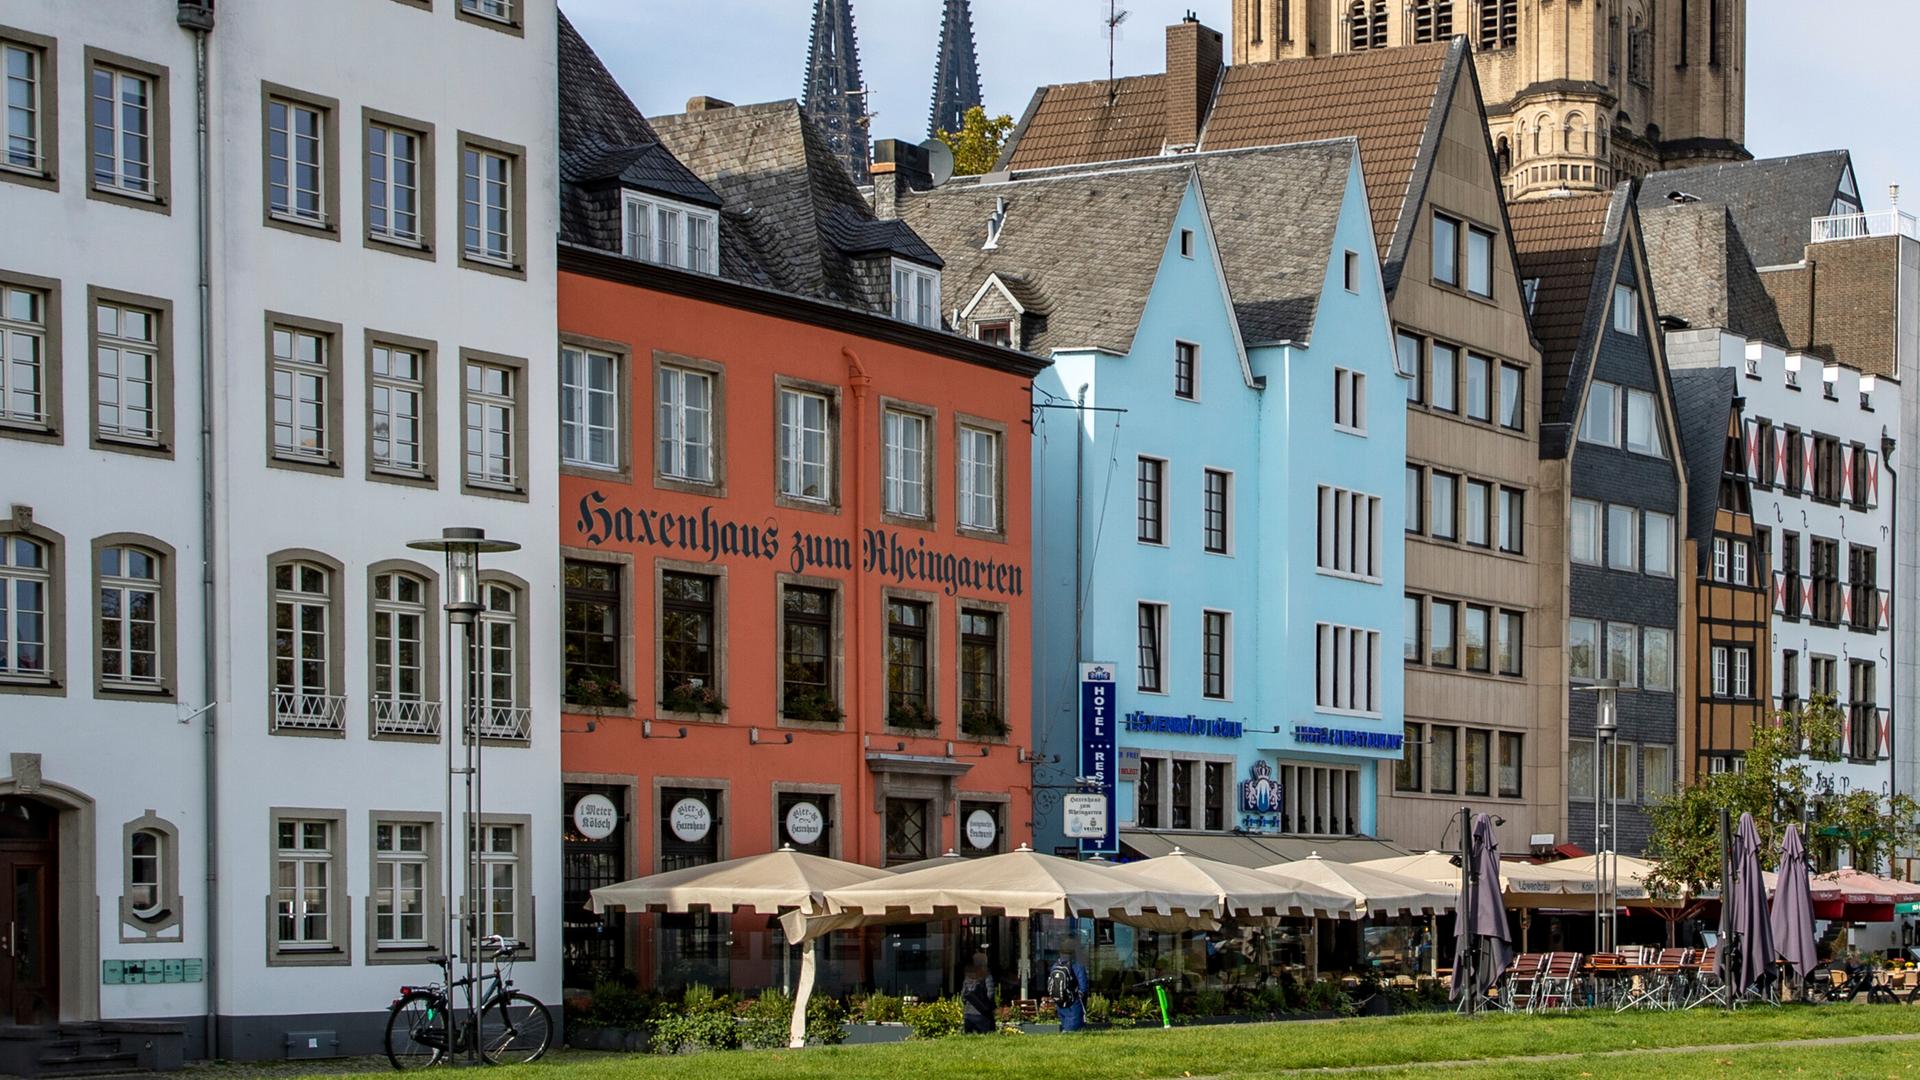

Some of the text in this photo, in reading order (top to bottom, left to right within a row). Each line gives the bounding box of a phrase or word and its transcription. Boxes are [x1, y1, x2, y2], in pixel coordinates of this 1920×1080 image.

[577, 490, 1024, 598] Haxenhaus zum Rheingarten
[1094, 686, 1104, 736] HOTEL
[582, 817, 611, 830] Kölsch
[586, 804, 613, 816] Meter
